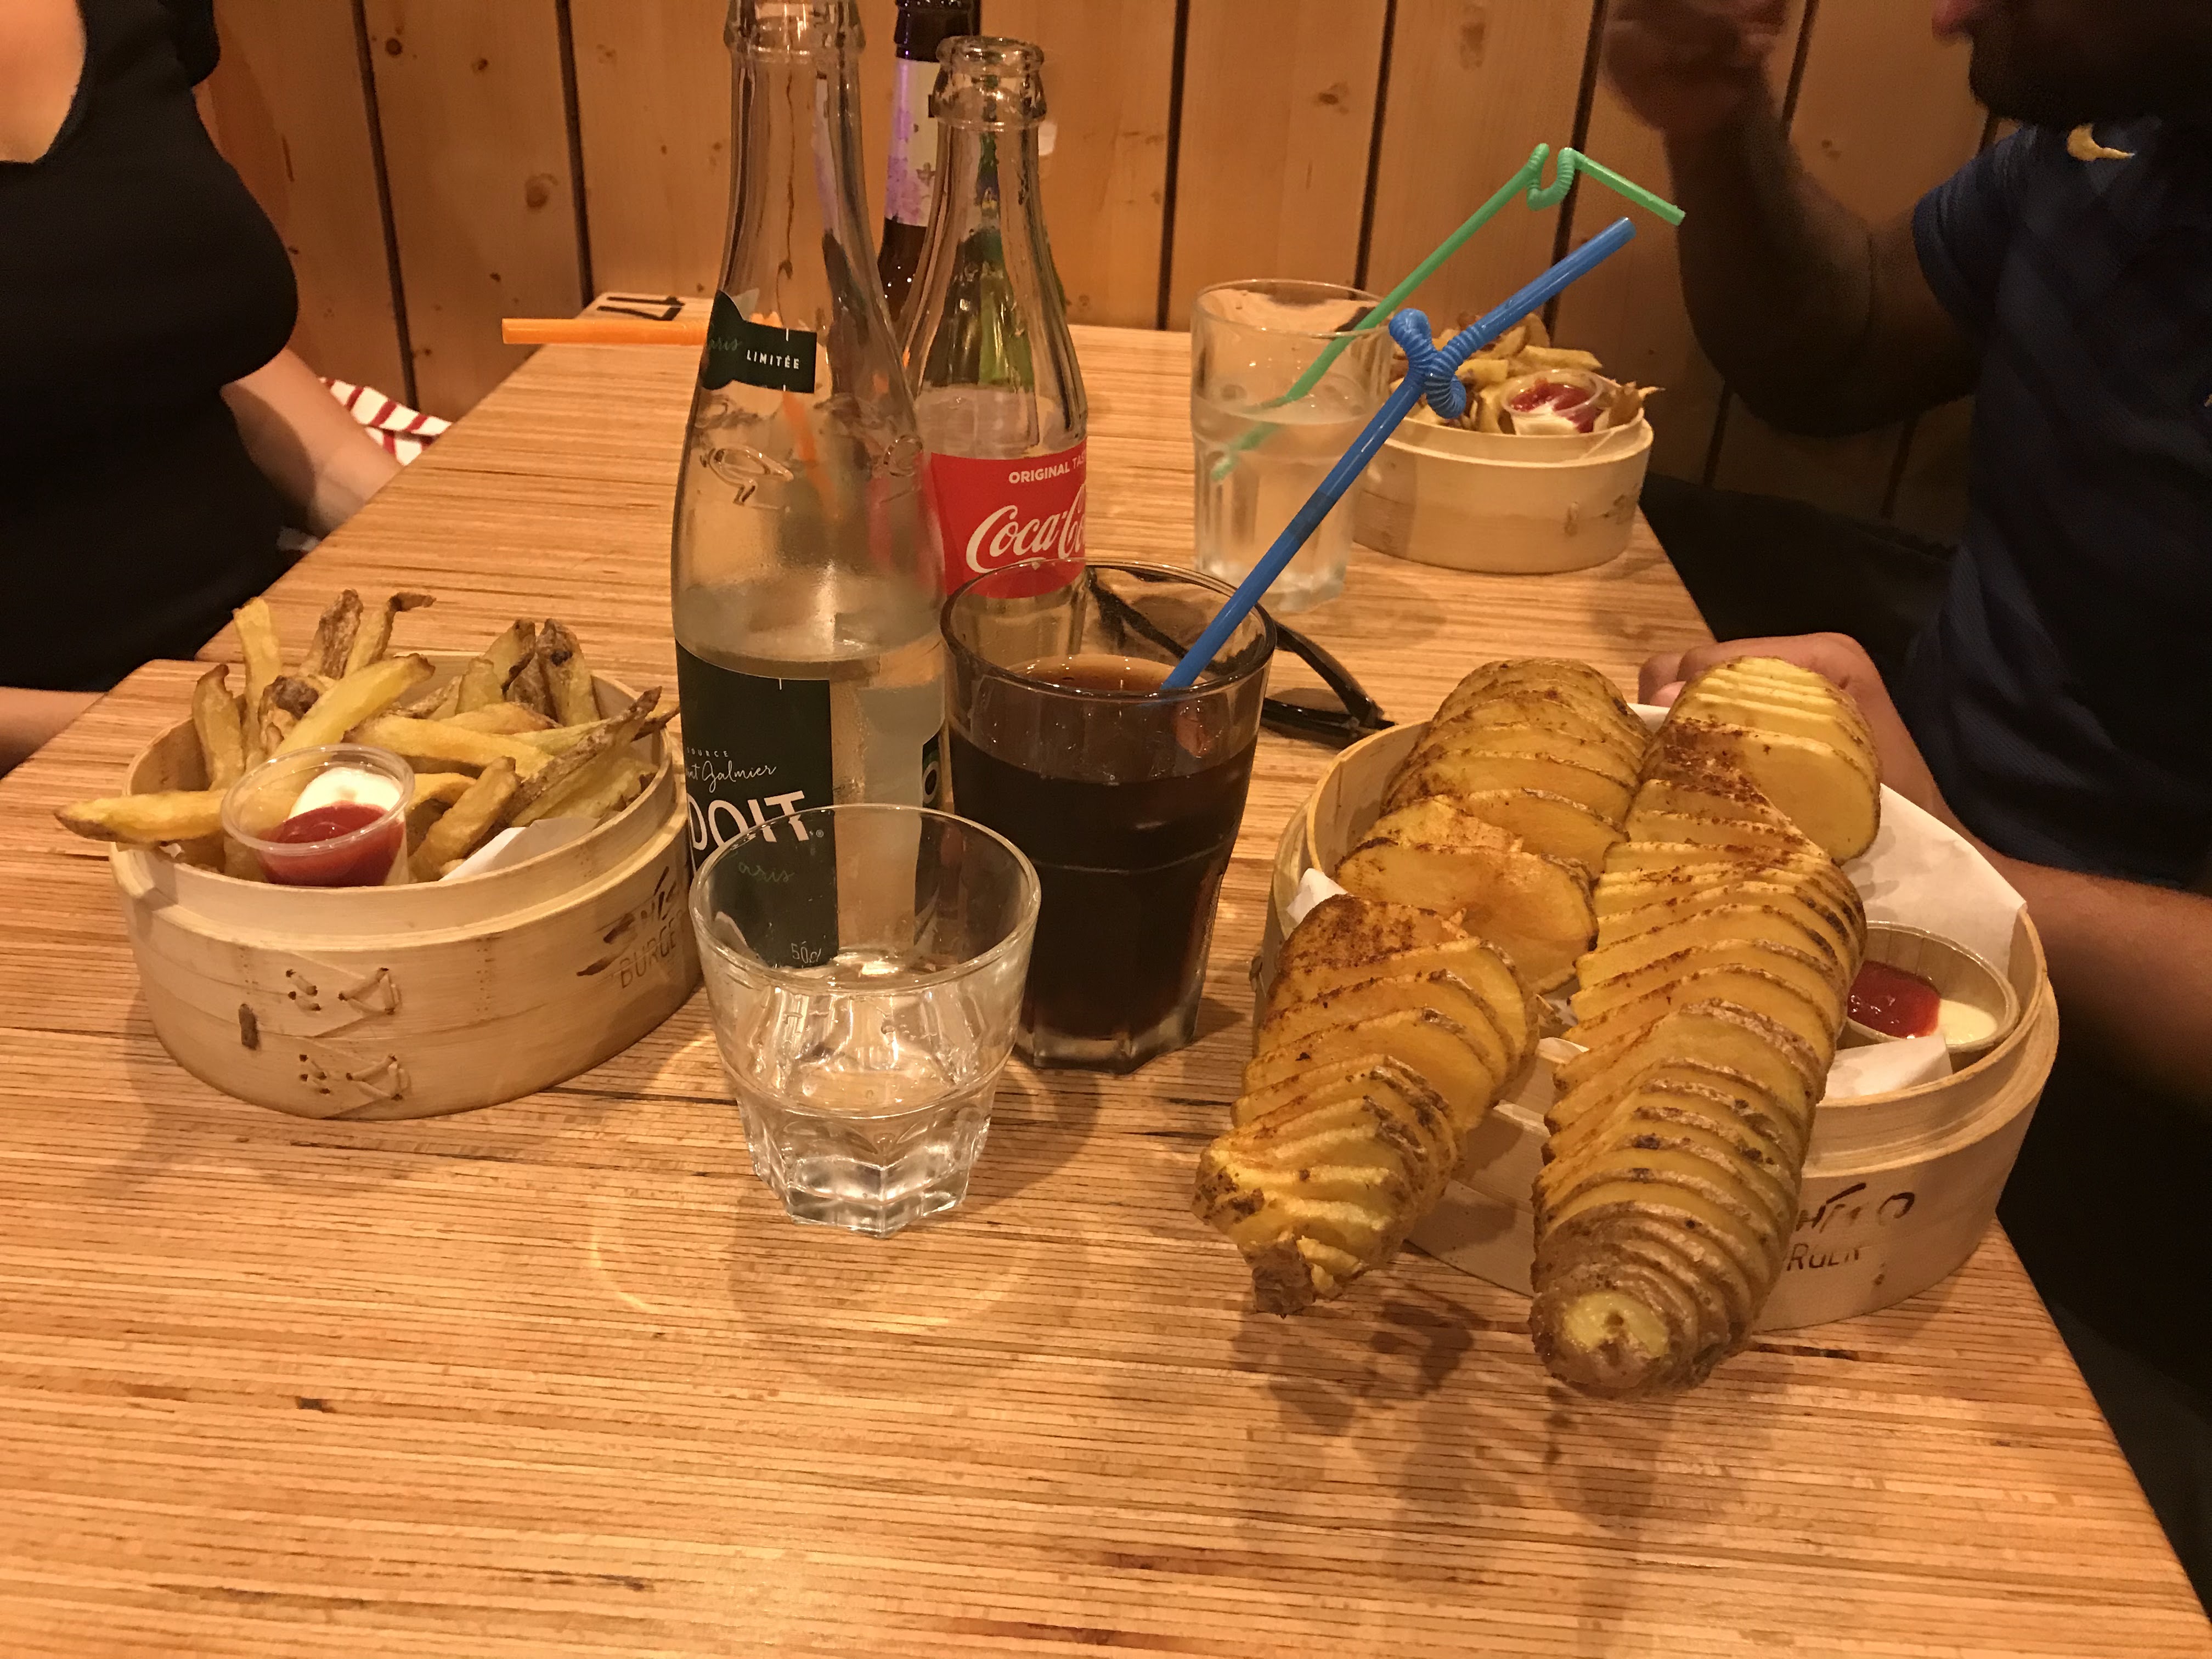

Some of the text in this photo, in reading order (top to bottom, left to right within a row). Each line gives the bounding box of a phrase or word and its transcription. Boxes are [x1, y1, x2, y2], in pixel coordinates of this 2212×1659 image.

[746, 349, 800, 370] LIMITÉE
[1008, 461, 1070, 484] ORIGINAL
[701, 760, 777, 793] Galmier
[687, 790, 810, 851] DOIT
